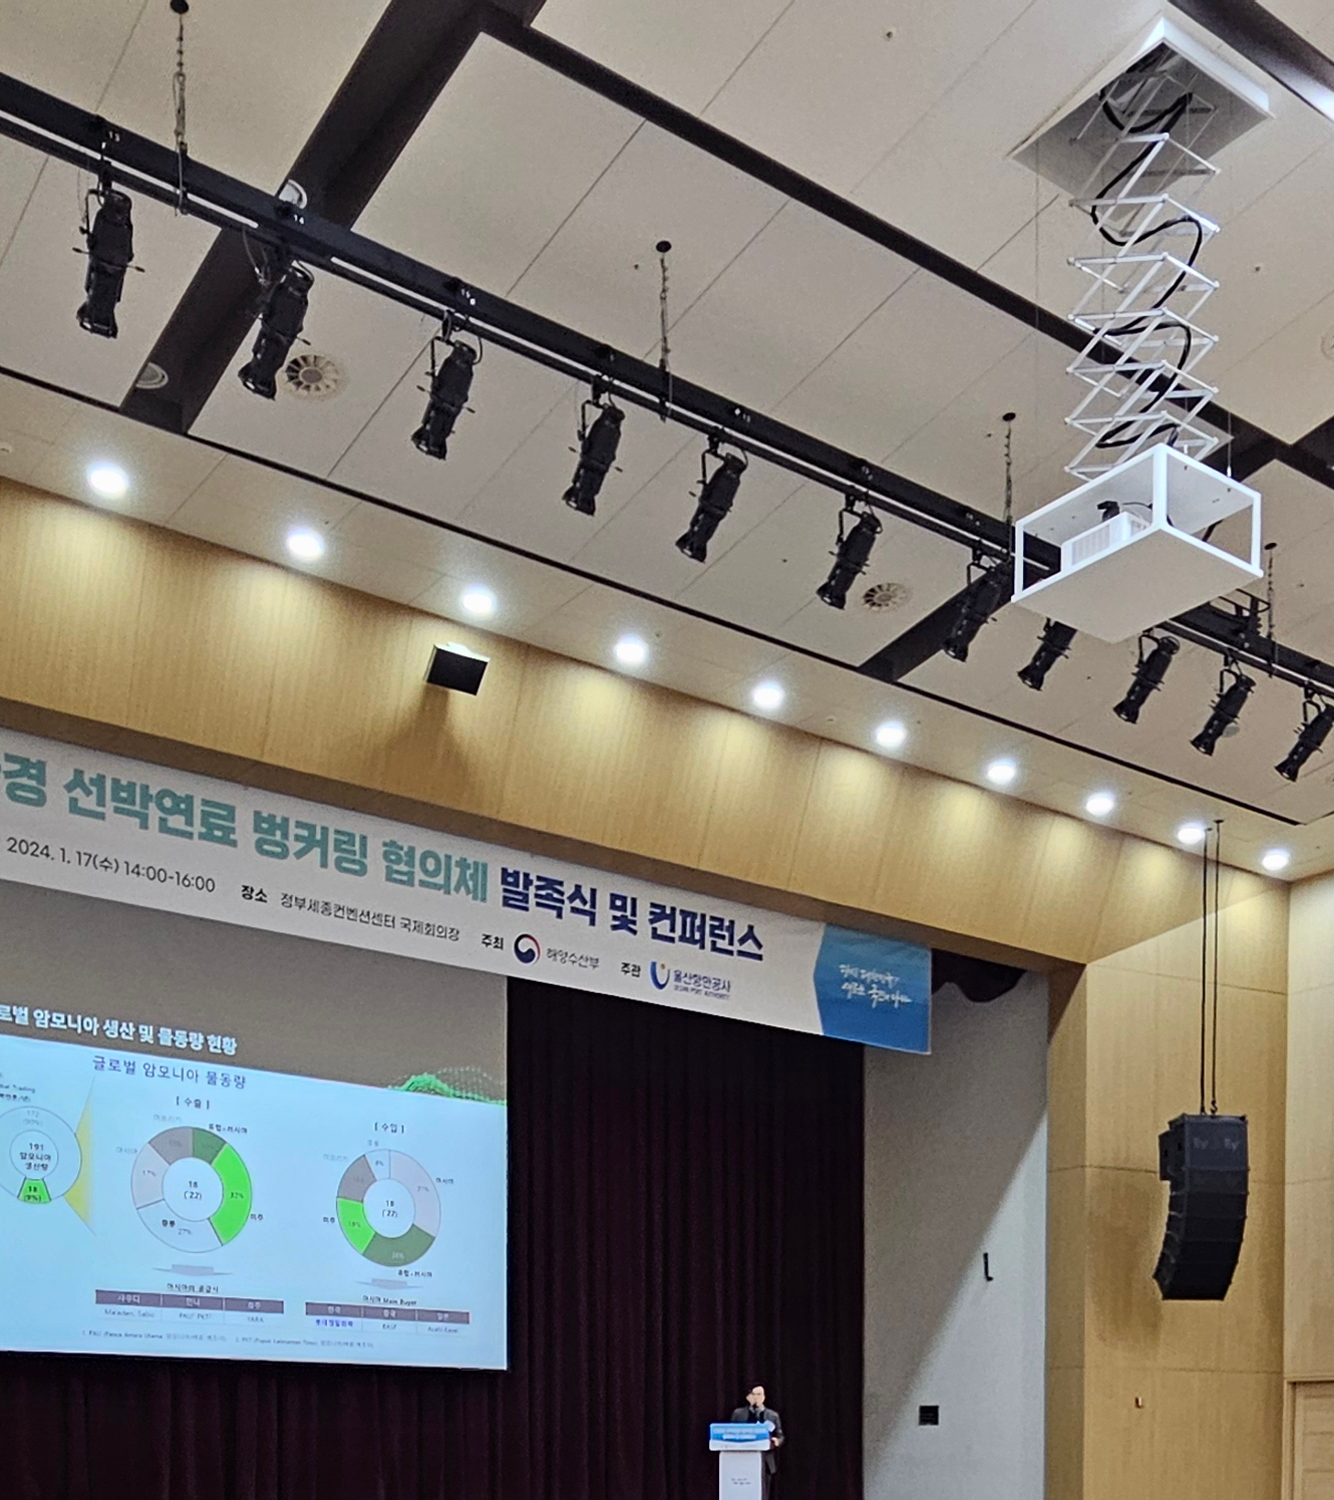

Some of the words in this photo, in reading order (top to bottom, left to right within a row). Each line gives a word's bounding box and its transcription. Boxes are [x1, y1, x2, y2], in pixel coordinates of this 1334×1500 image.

[7, 837, 55, 861] 2024.
[76, 851, 119, 874] 17(수)
[124, 861, 216, 892] 14:00-16:00
[63, 768, 238, 848] 선박연료
[253, 810, 367, 877] 벙커링
[382, 839, 488, 904] 협의체
[500, 867, 597, 926] 발족식
[609, 892, 638, 936] 및
[648, 901, 764, 961] 컨퍼런스
[241, 884, 268, 903] 장소
[280, 892, 395, 929] 정부세종컨벤션센터
[400, 916, 460, 941] 국제회의장
[481, 934, 504, 950] 주최
[546, 948, 600, 969] 해양수산부
[621, 962, 641, 978] 주관
[33, 1008, 99, 1036] 암모니아
[103, 1019, 136, 1041] 생산
[138, 1025, 154, 1044] 및
[206, 1034, 237, 1056] 현황
[92, 1055, 136, 1075] 글로벌
[143, 1062, 199, 1083] 암모니아
[205, 1070, 247, 1089] 물동량
